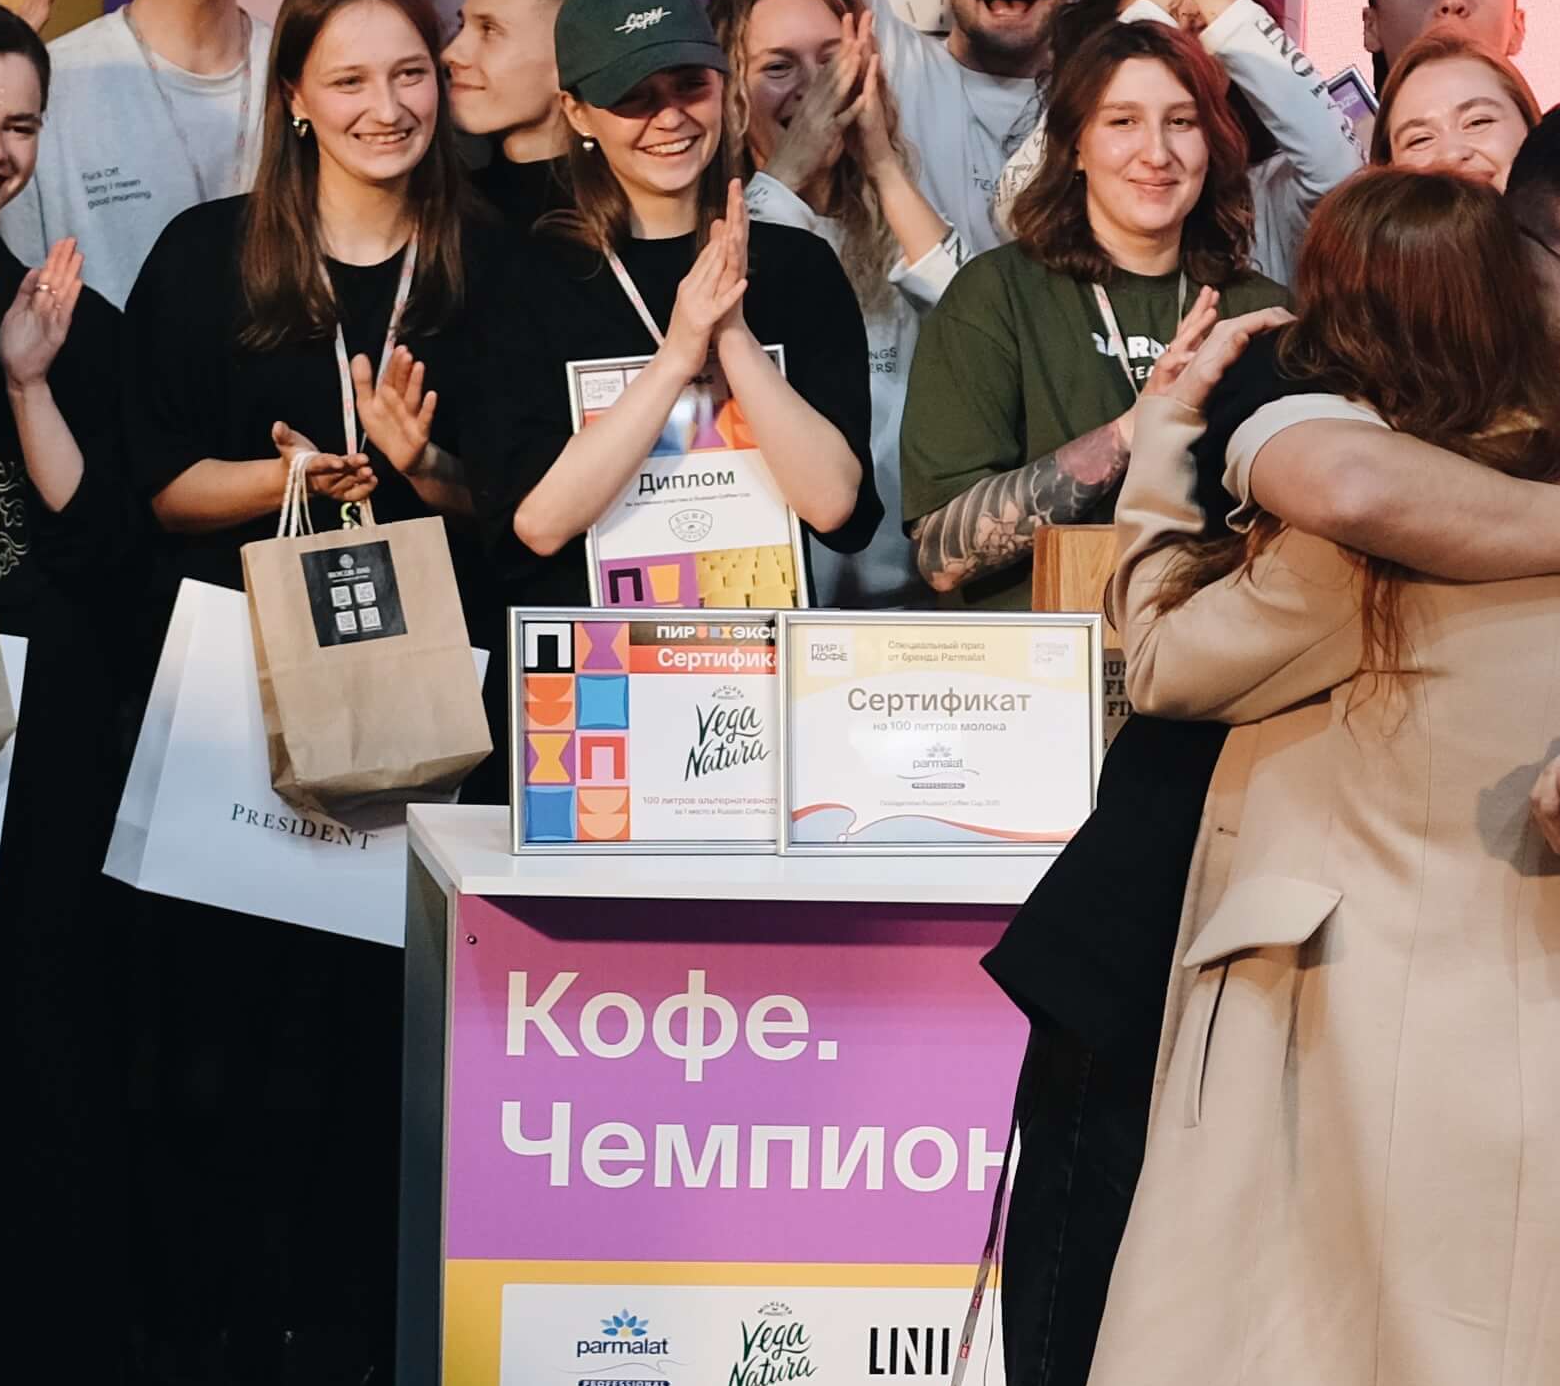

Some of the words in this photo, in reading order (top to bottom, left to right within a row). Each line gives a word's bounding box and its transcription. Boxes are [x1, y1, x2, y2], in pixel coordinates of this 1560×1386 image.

[639, 470, 736, 496] Диплом
[656, 625, 696, 639] ПИР
[811, 644, 838, 653] ПИР
[811, 652, 848, 662] КОФЕ
[847, 687, 1032, 717] Сертификат
[696, 704, 763, 746] Vega
[873, 723, 887, 731] на
[890, 720, 912, 731] 100
[914, 722, 958, 733] литров
[960, 723, 1006, 732] молока
[685, 740, 771, 781] Natura
[504, 970, 838, 1081] Кофе.
[576, 1338, 669, 1358] parmalat
[740, 1320, 813, 1359] Vega
